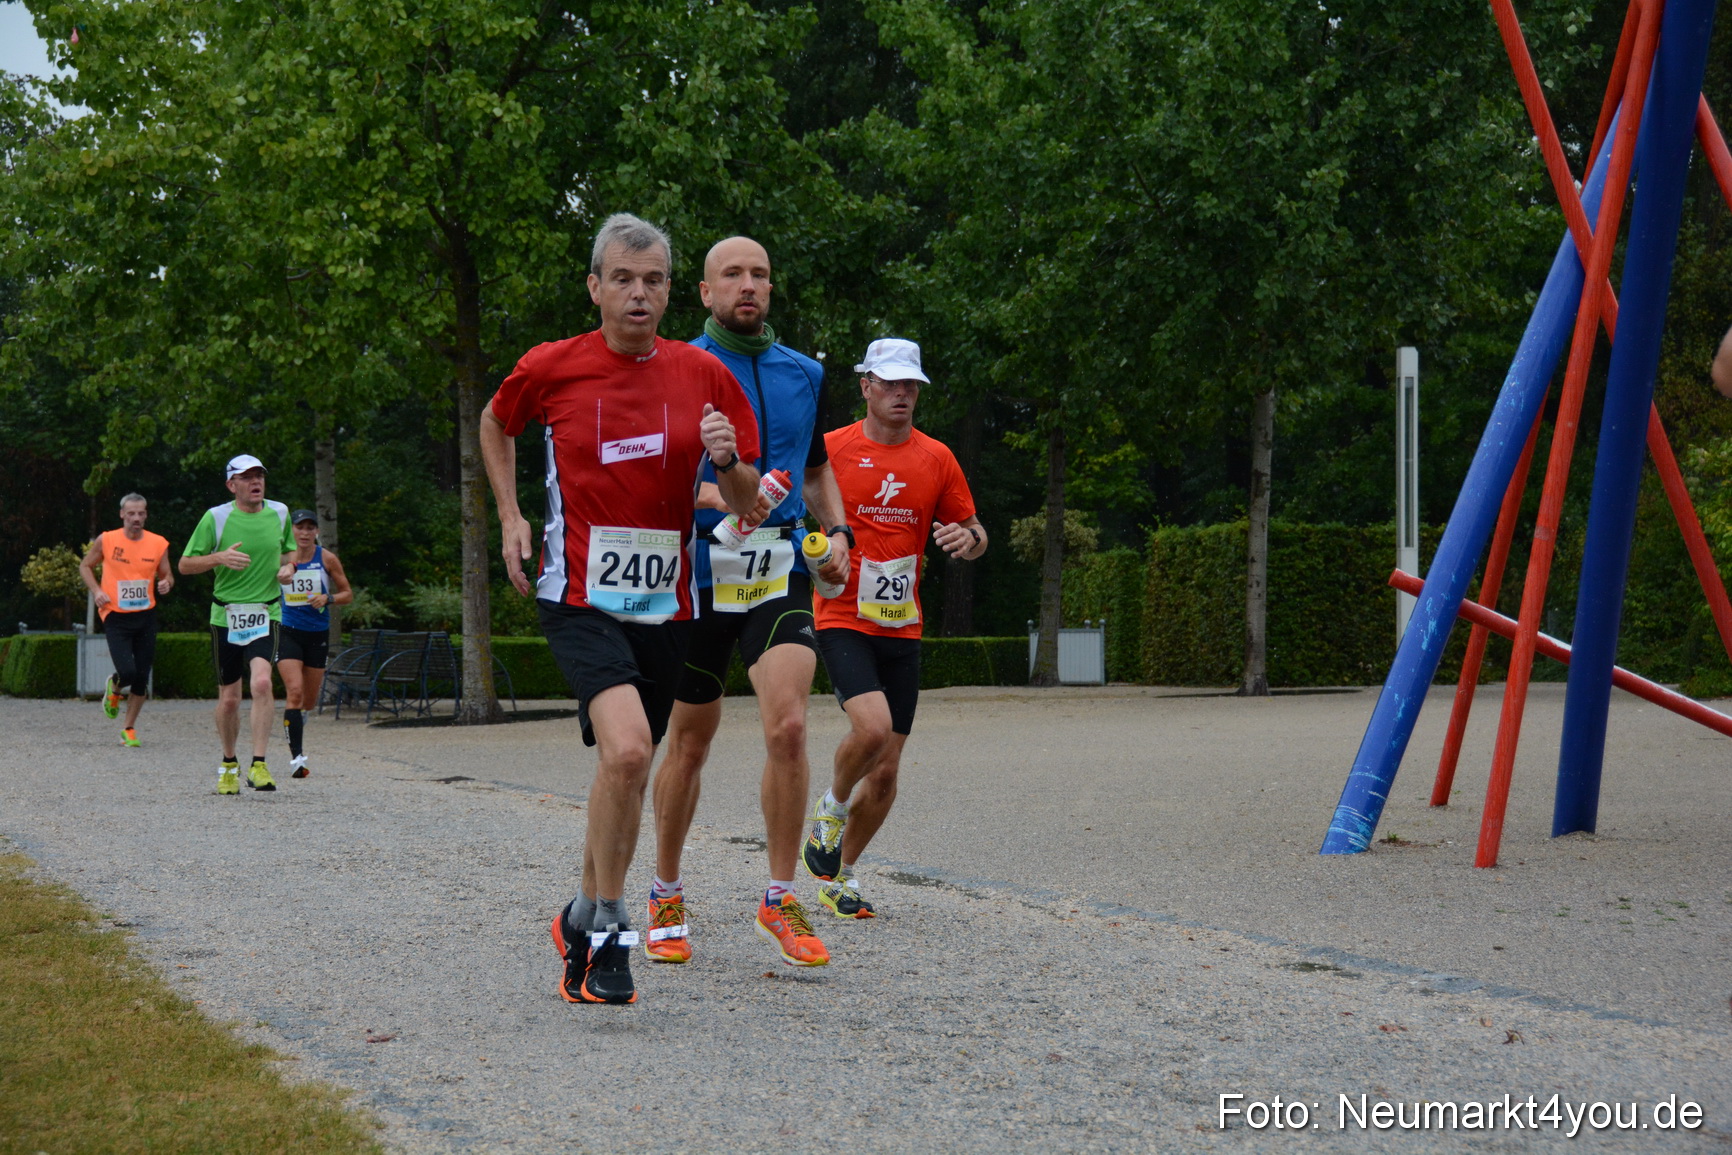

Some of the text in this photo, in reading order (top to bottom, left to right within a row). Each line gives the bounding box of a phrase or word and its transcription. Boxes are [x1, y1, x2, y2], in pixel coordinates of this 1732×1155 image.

[618, 443, 646, 456] DEHN
[856, 504, 913, 516] funrunners
[872, 514, 919, 525] neumarkt
[599, 551, 678, 589] 2404
[740, 549, 771, 580] 74
[292, 579, 313, 592] 133
[875, 574, 909, 601] 297
[624, 597, 651, 612] Ernst
[230, 614, 266, 630] 2590
